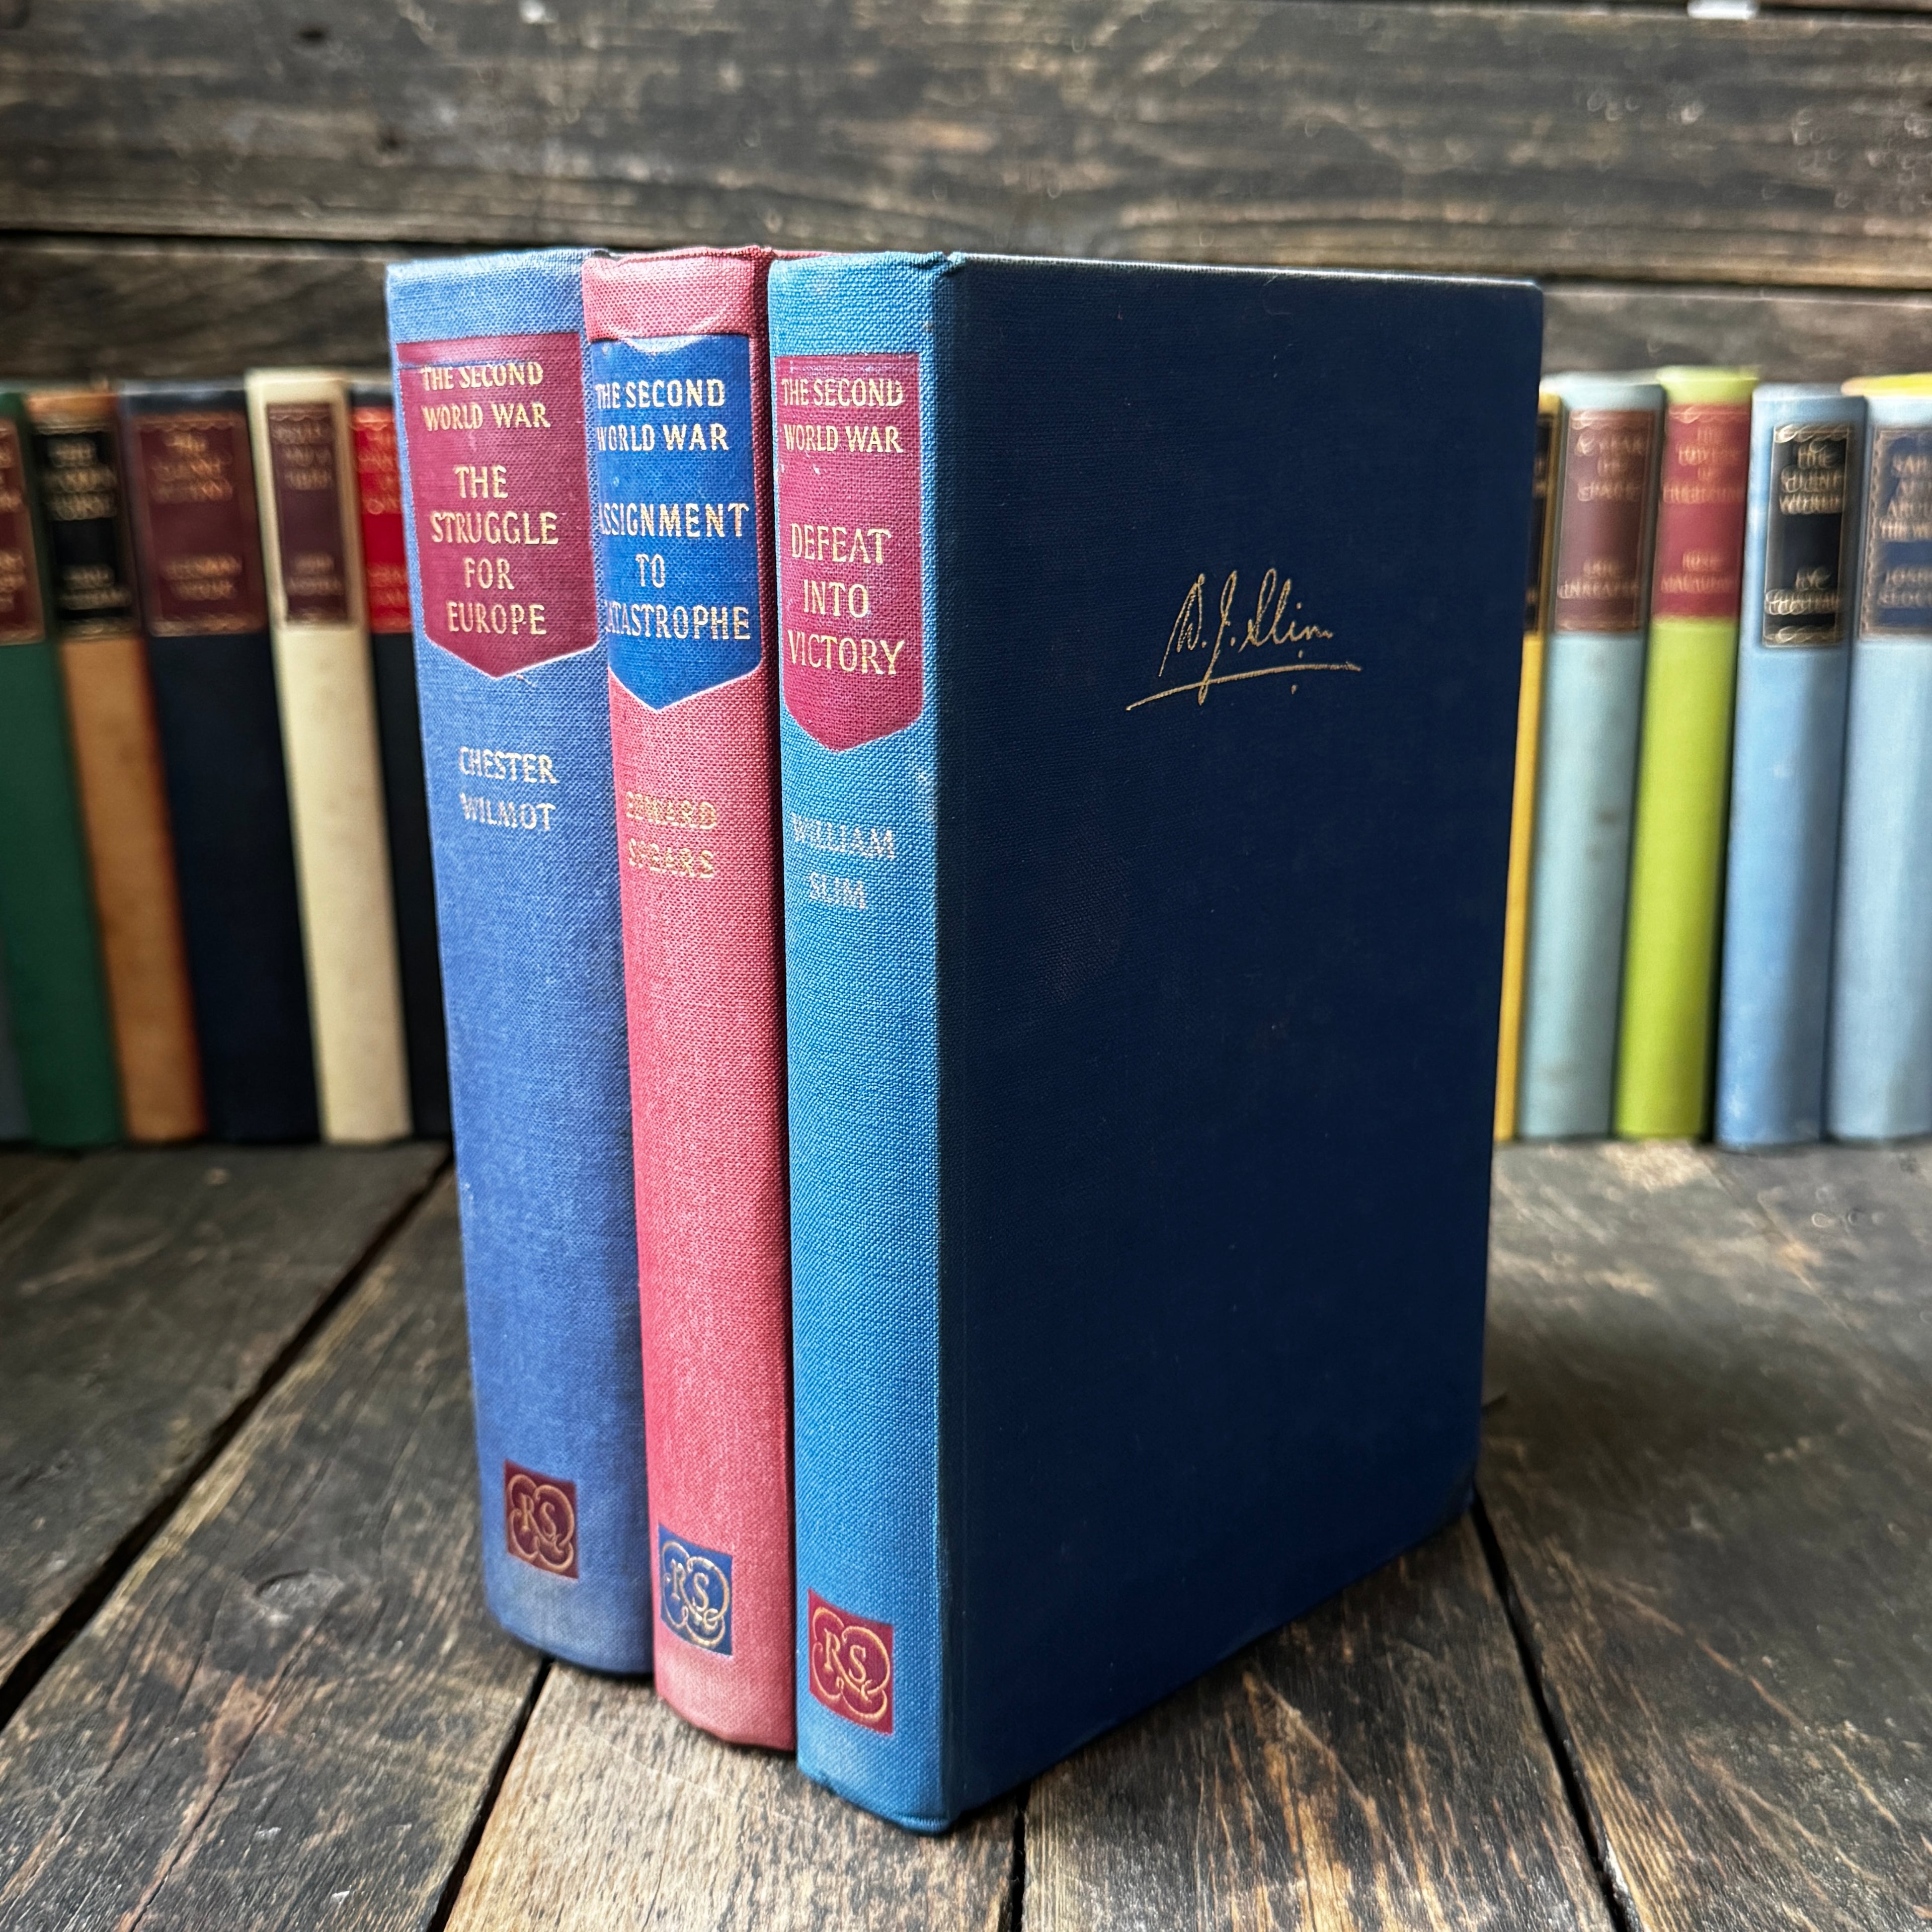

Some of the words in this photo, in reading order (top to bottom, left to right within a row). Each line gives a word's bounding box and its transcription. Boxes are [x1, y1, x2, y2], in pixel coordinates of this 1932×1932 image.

[420, 366, 453, 391] THE
[460, 362, 543, 389] SECOND
[595, 381, 621, 409] THE
[626, 379, 726, 409] SECOND
[782, 378, 809, 407] THE
[813, 378, 904, 408] SECOND
[422, 404, 483, 431] WORLD
[492, 402, 551, 429] WAR
[597, 424, 655, 451] WORLD
[663, 423, 730, 451] WAR
[783, 424, 839, 452] WORLD
[845, 425, 904, 453] WAR
[454, 464, 508, 499] THE
[431, 510, 559, 545] STRUGGLE
[790, 523, 892, 565] DEFEAT
[464, 557, 515, 590] FOR
[635, 553, 666, 588] TO
[803, 579, 869, 619] INTO
[446, 601, 547, 635] EUROPE
[787, 630, 905, 675] VICTORY
[458, 746, 559, 784] CHESTER
[459, 792, 556, 830] WILMOT
[791, 812, 895, 859] WILLIAM
[809, 871, 866, 909] SLIM
